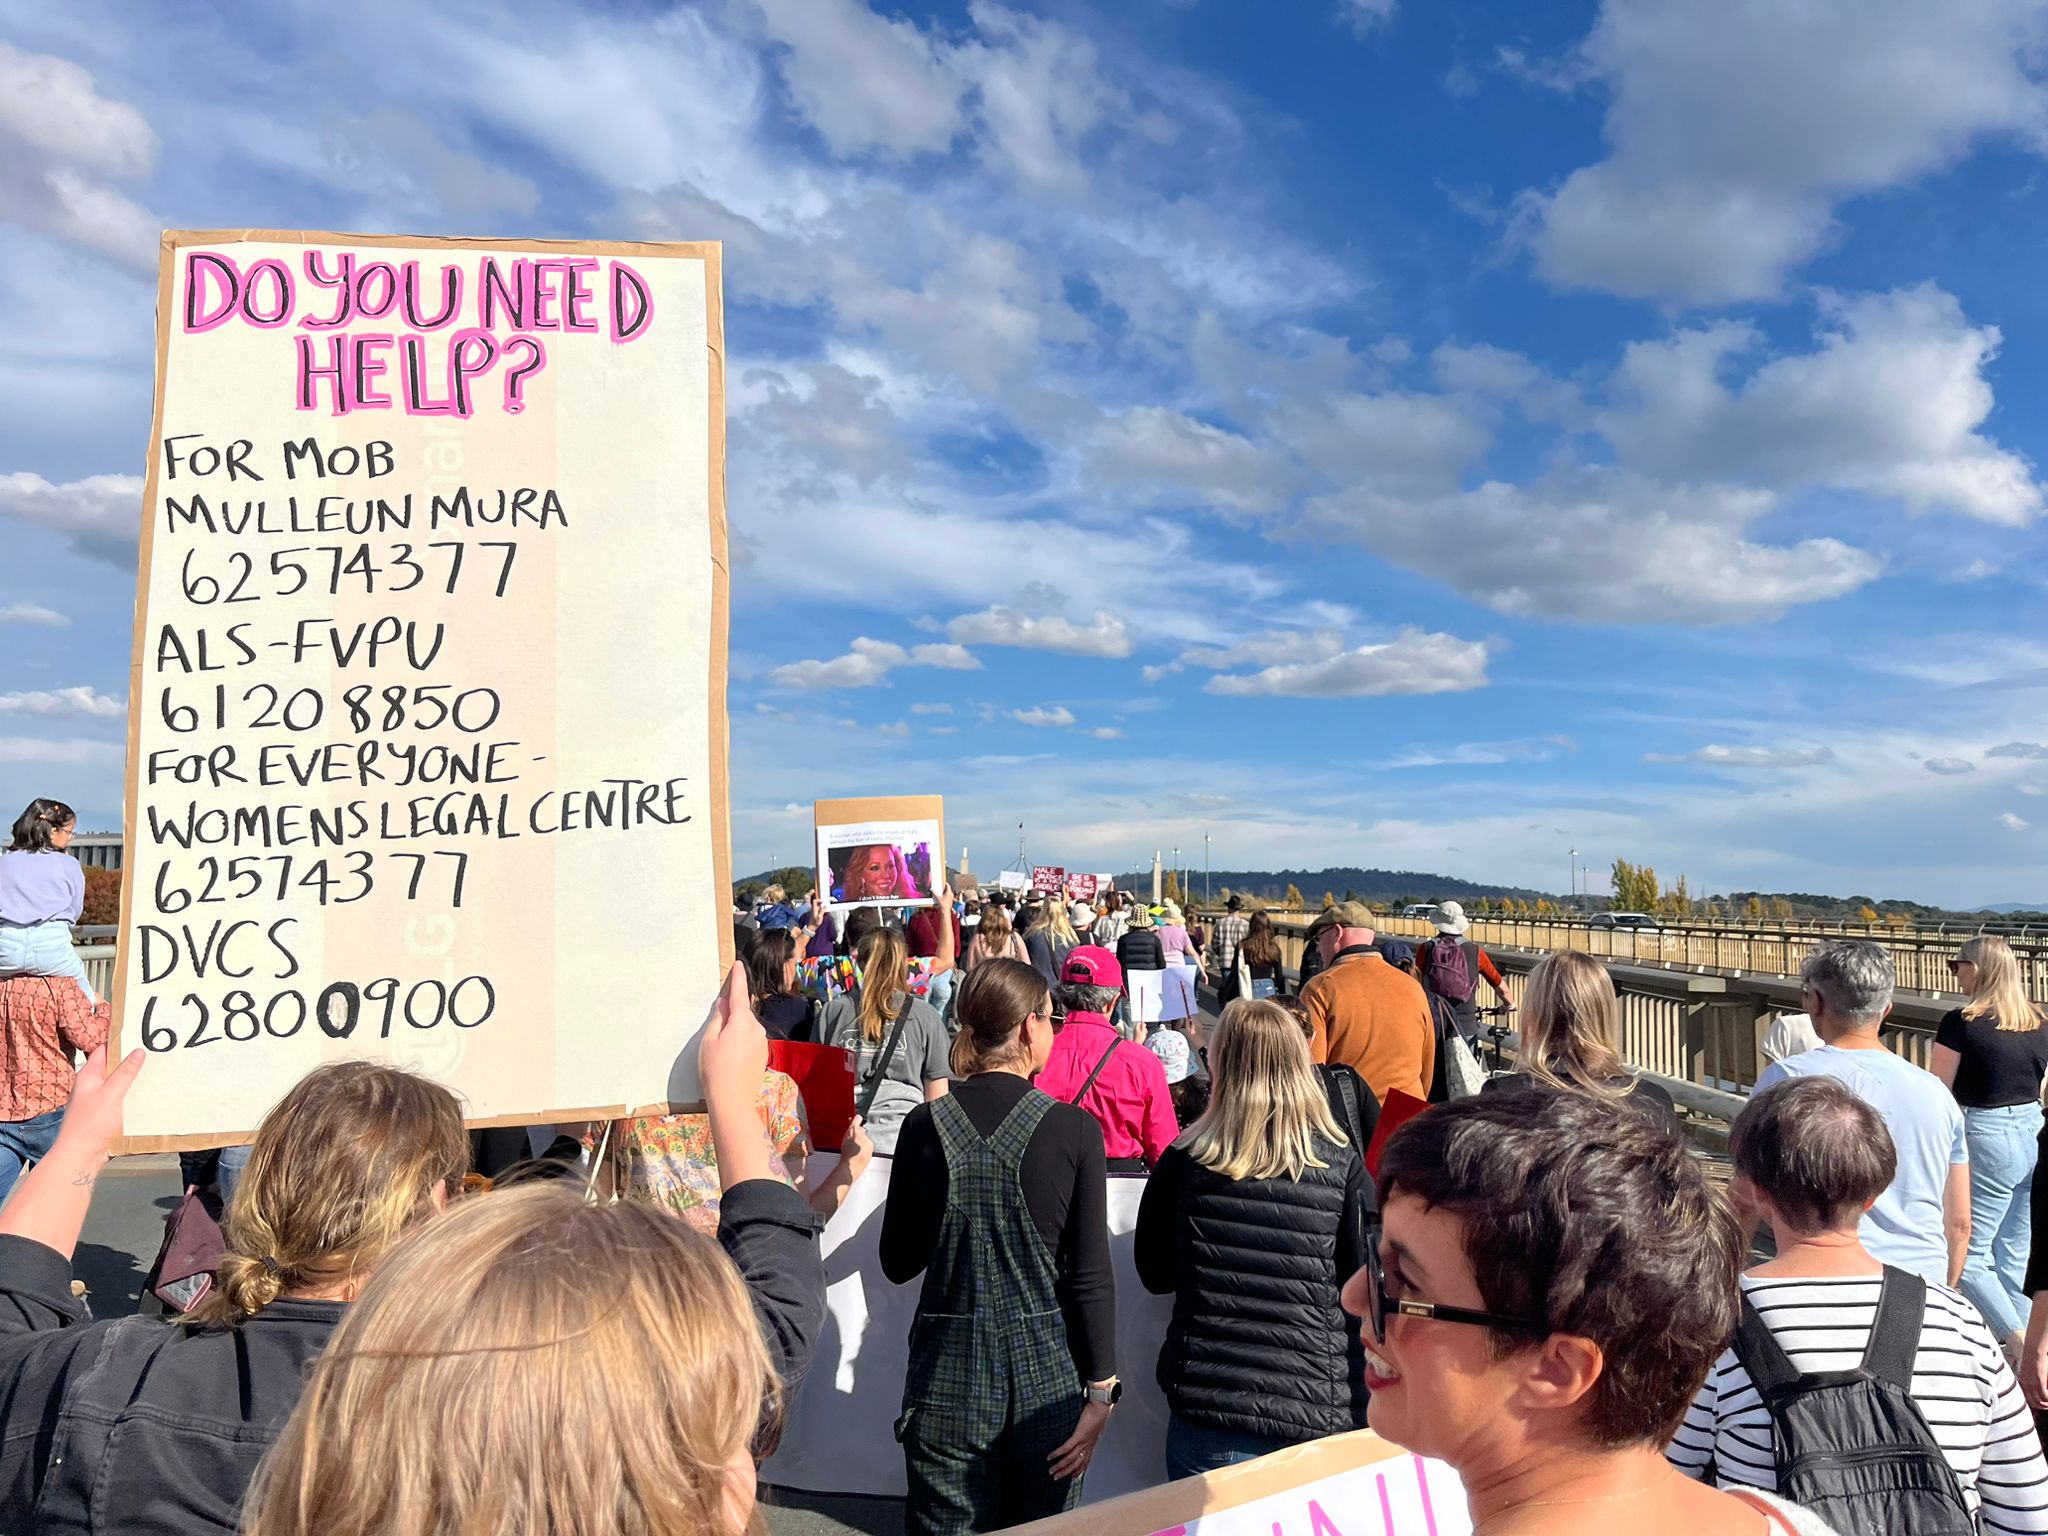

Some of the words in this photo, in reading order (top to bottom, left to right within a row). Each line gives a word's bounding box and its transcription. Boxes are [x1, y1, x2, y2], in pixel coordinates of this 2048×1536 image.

[183, 251, 296, 335] DO
[299, 249, 464, 333] YOU
[478, 256, 655, 345] NEED
[295, 331, 547, 418] HELP?
[164, 434, 264, 482] FOR
[283, 437, 394, 480] MOB
[165, 493, 412, 535] MULLEUN
[431, 487, 568, 530] MURA
[182, 542, 517, 605] 62574377
[157, 617, 444, 674] ALS-FVPU
[161, 684, 324, 733] 6120
[342, 684, 500, 734] 8850
[148, 745, 248, 788] FOR
[147, 800, 369, 849] WOMENS
[380, 791, 521, 840] LEGAL
[529, 777, 692, 834] CENTRE
[155, 850, 468, 914] 62574377
[136, 918, 299, 984] DVCS
[141, 975, 495, 1053] 62800900
